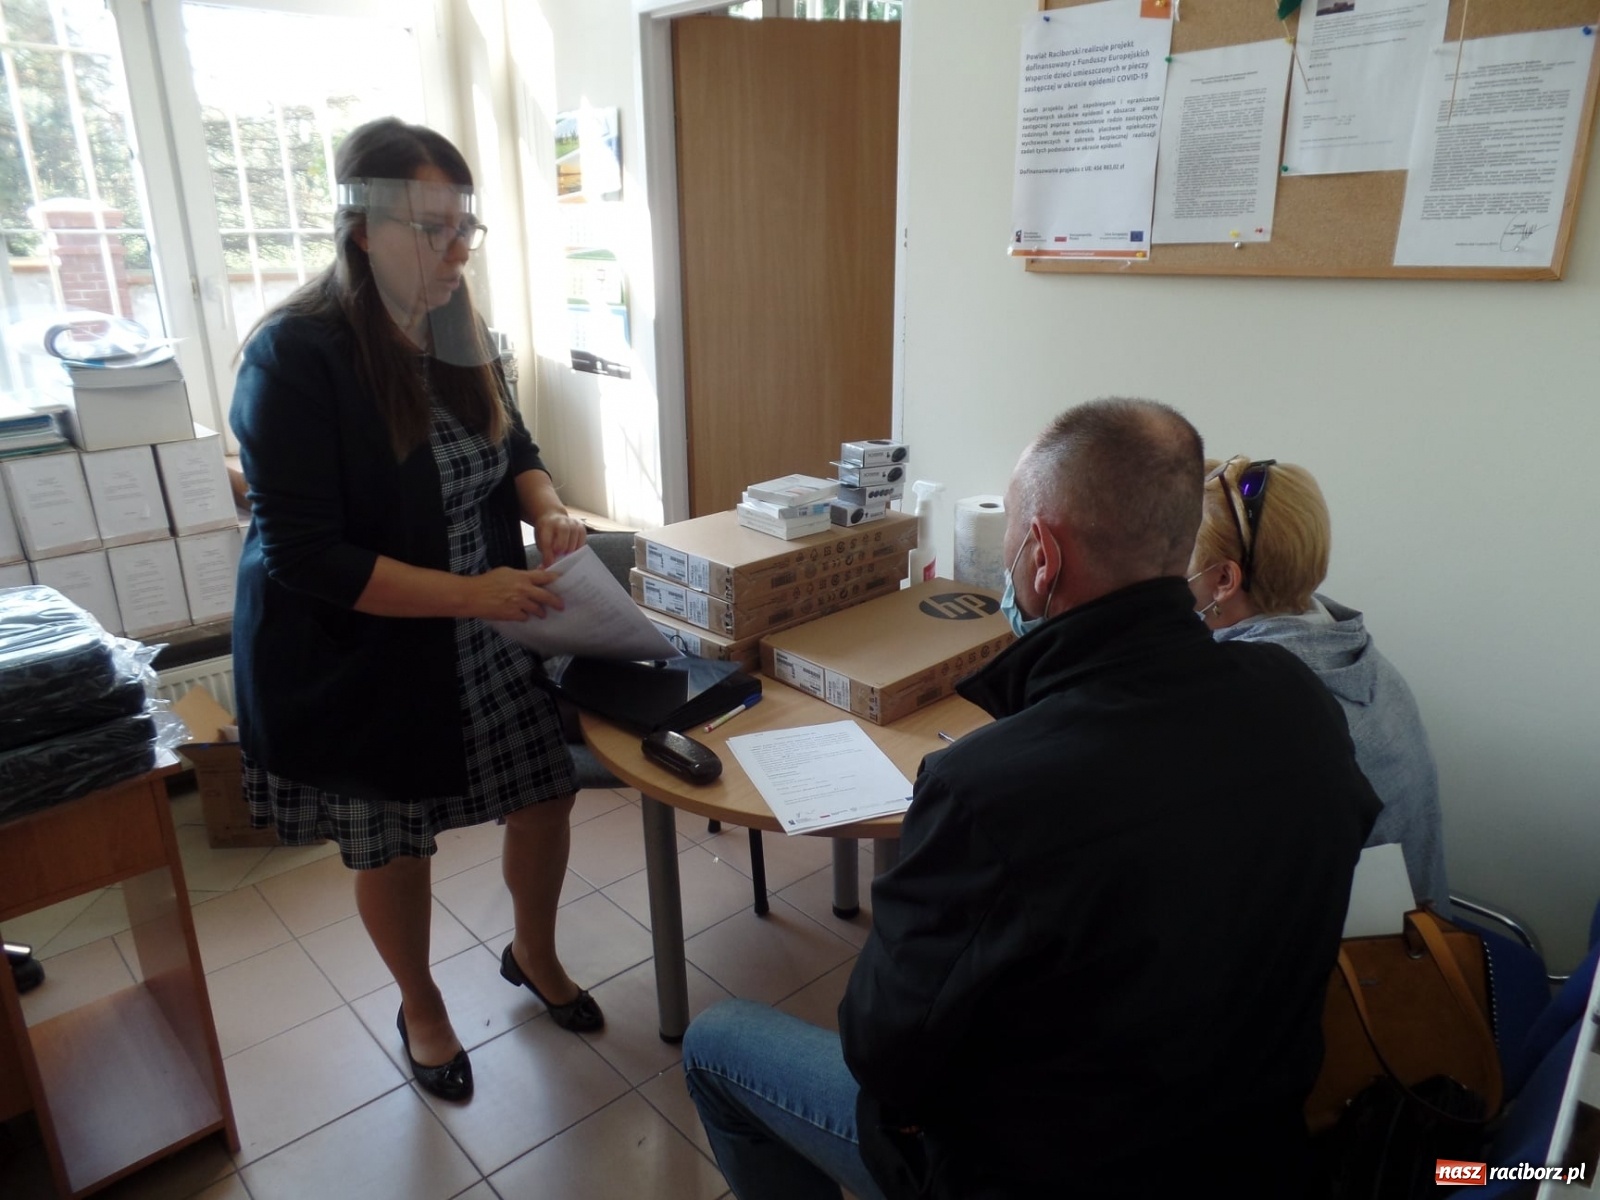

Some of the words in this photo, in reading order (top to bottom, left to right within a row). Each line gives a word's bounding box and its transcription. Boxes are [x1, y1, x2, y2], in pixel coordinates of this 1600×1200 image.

[1026, 52, 1047, 60] Powiat
[1049, 48, 1081, 58] Raciborski
[1082, 45, 1109, 53] realizuje
[1110, 41, 1134, 51] projekt
[1026, 62, 1071, 71] dofinansowany
[1077, 56, 1107, 65] Funduszy
[1109, 49, 1149, 61] Europejskich
[1024, 83, 1056, 93] zastępczej
[1063, 81, 1087, 89] okresie
[1088, 76, 1116, 86] epidemii
[1117, 72, 1148, 82] COVID-19
[1025, 73, 1052, 82] Wsparcie
[1073, 65, 1120, 76] umieszczonych
[1128, 62, 1149, 71] pieczy
[920, 593, 998, 620] hp
